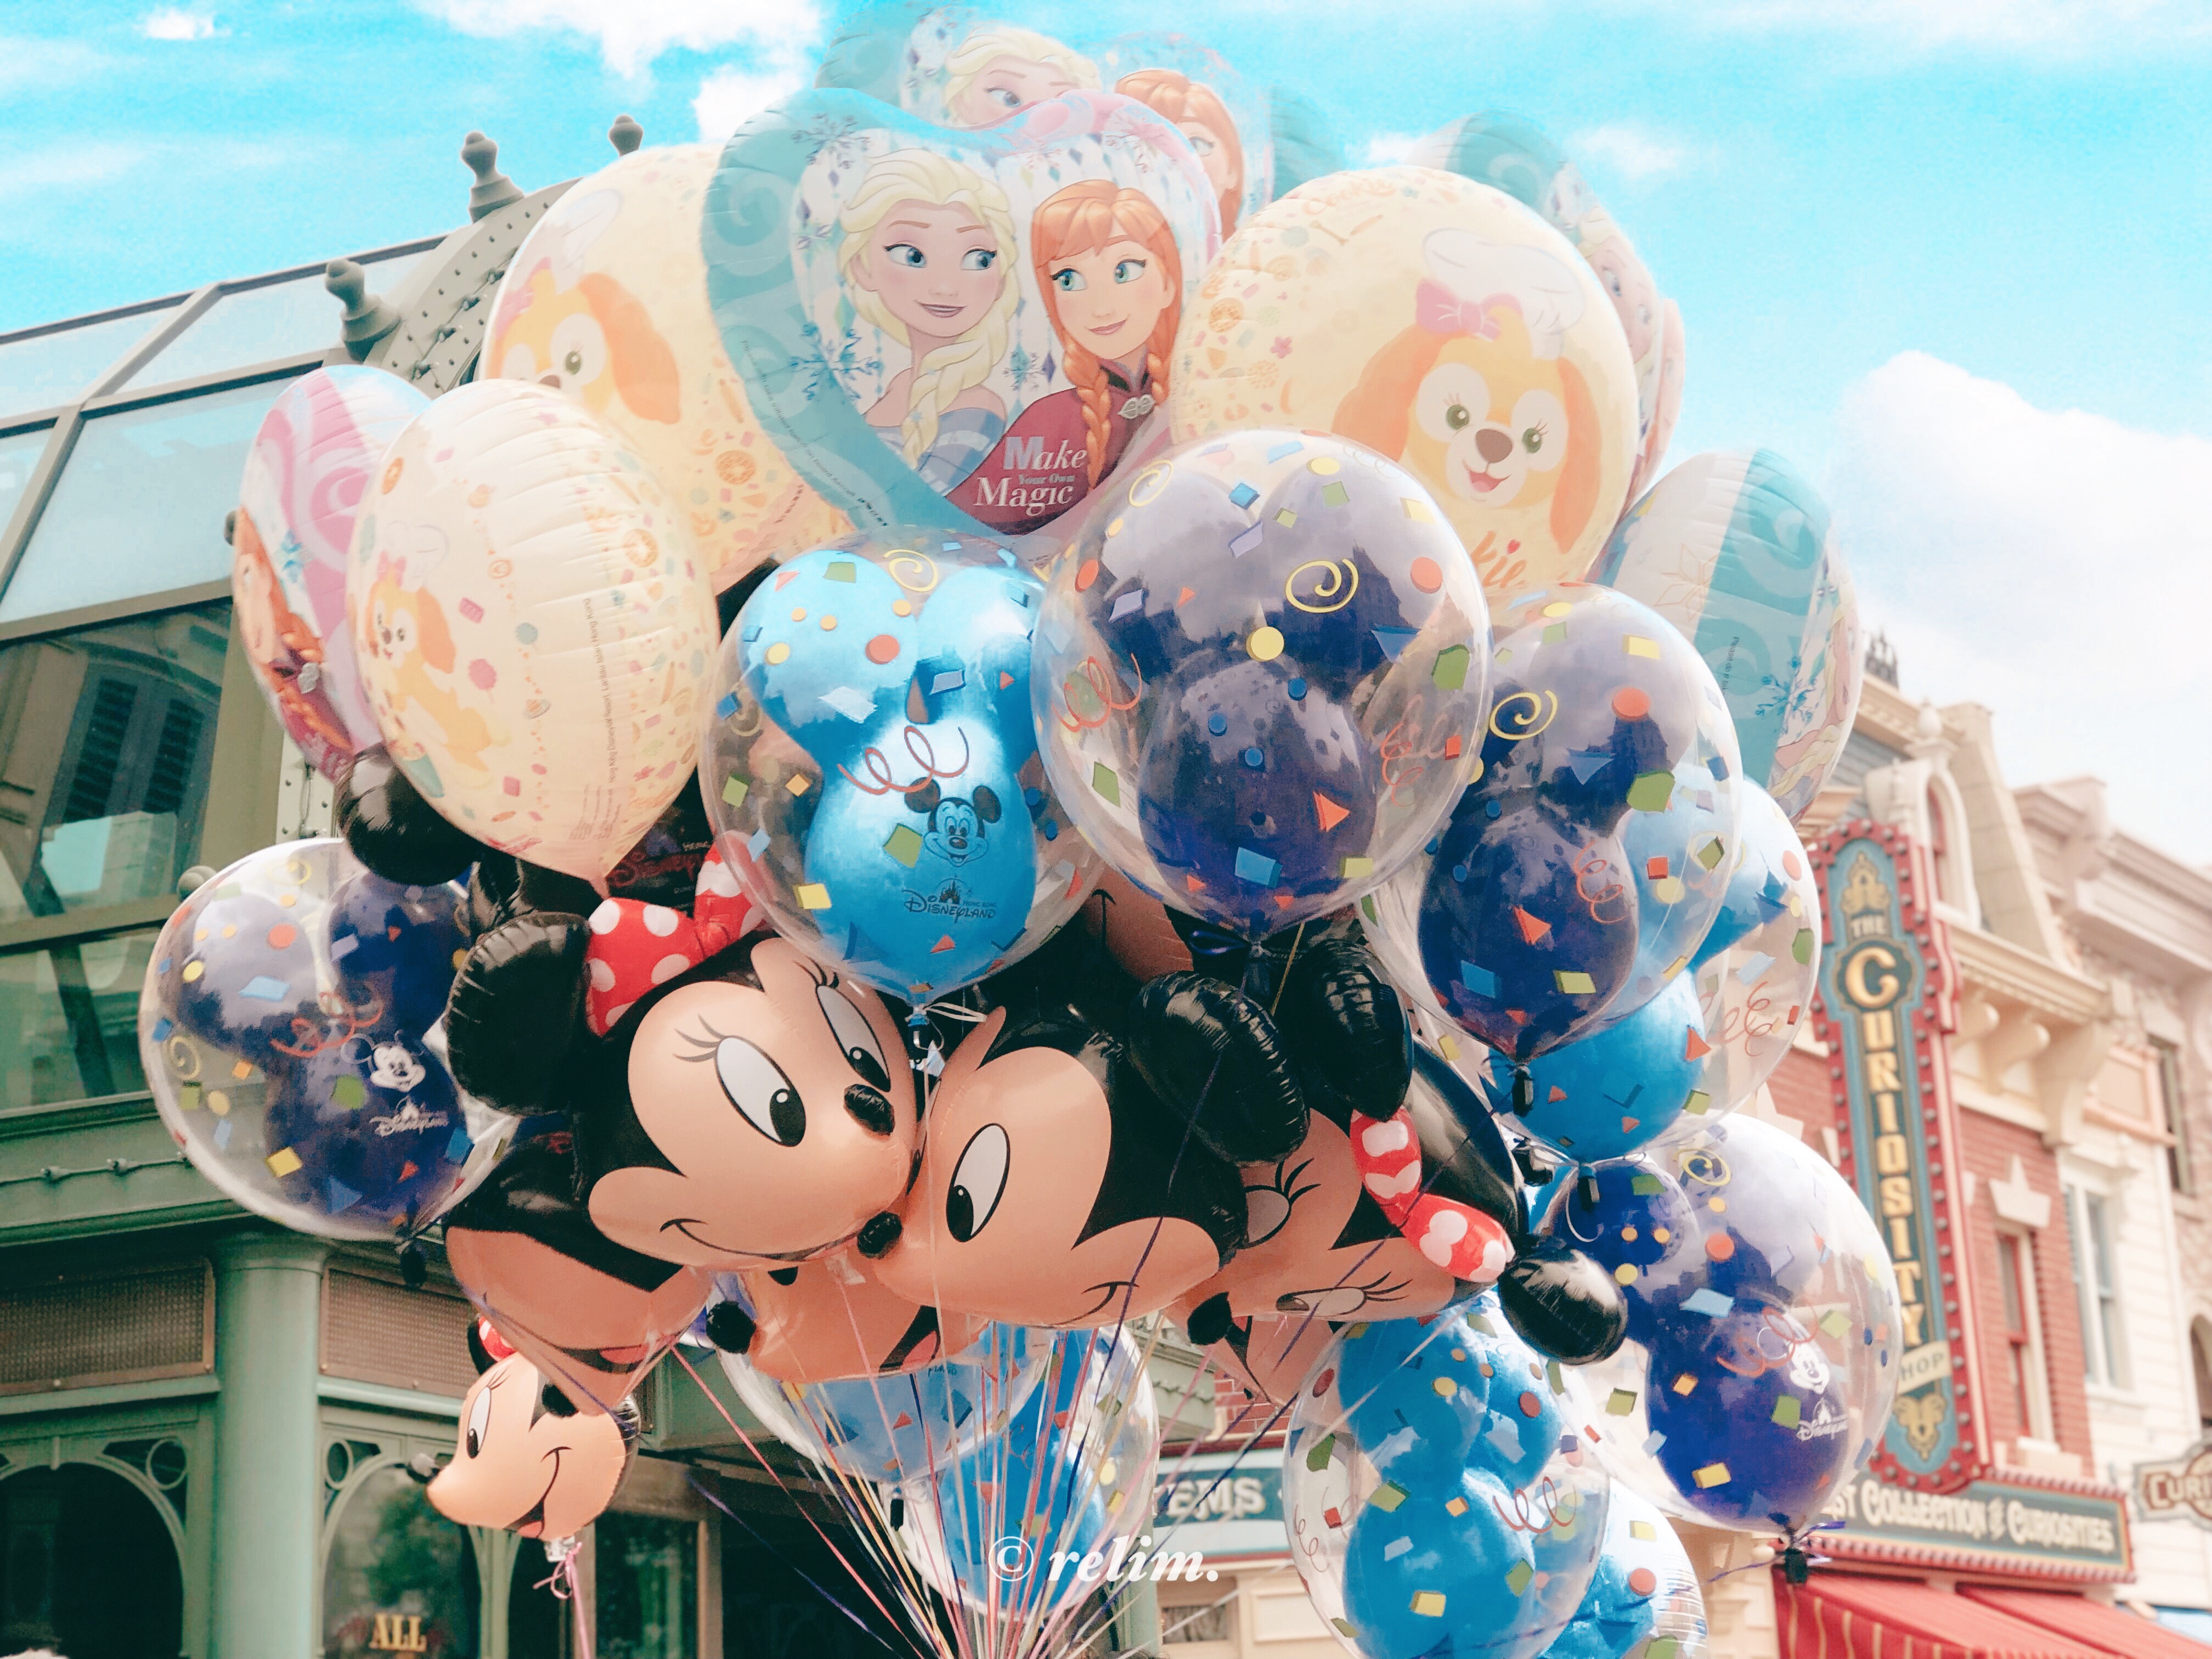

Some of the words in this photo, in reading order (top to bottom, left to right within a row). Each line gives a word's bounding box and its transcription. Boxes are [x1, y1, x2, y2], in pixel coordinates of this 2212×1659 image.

[1003, 437, 1087, 470] Make
[974, 477, 1074, 516] Magic
[1852, 916, 1886, 938] THE
[1846, 947, 1923, 1345] CURIOSITY
[1900, 1352, 1945, 1381] HOP
[1861, 1480, 1988, 1539] COLLECTION
[2007, 1500, 2115, 1553] CURIOSITIES
[370, 1614, 427, 1651] ALL
